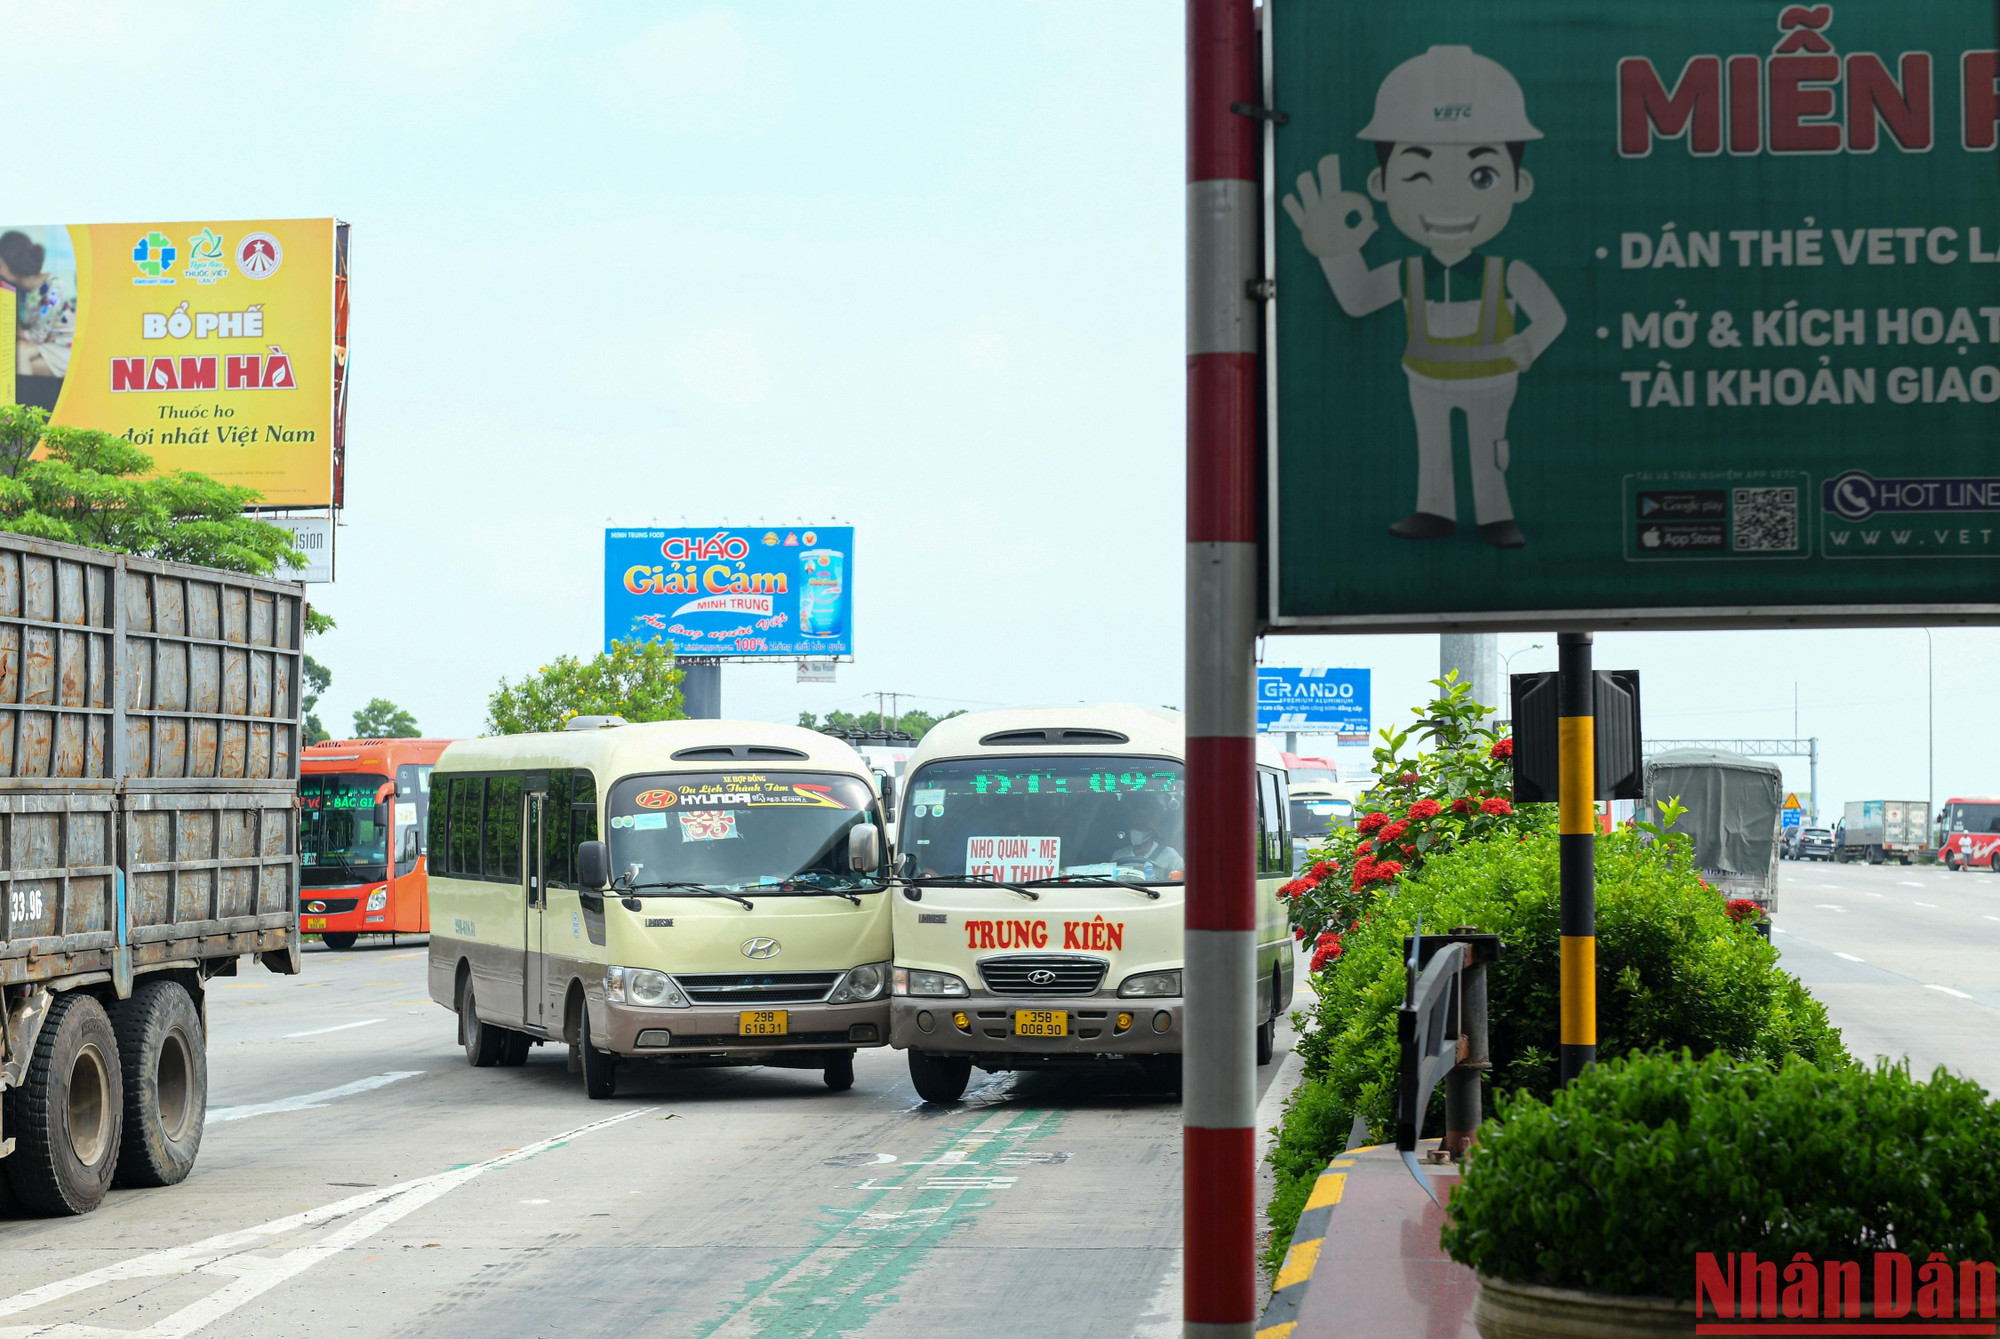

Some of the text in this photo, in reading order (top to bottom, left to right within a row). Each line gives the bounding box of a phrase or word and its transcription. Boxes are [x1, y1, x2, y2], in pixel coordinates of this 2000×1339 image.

[1617, 4, 1934, 158] MIỄN
[1621, 221, 1721, 269] DÁN
[1729, 216, 1824, 267] THẺ
[1831, 226, 1959, 266] VETC
[142, 301, 266, 340] BỔ PHẾ
[1622, 298, 2000, 355] MỞ & KÍCH HOẠT
[110, 345, 298, 393] NAM HÀ
[1620, 355, 2000, 408] TÀI KHOẢN GIAO
[158, 404, 235, 420] Thuốc ho
[161, 426, 209, 445] nhất
[216, 425, 259, 447] Việt
[264, 425, 316, 443] Nam
[1881, 483, 2000, 507] HOT LINE
[661, 531, 750, 561] CHÁO
[1664, 533, 1722, 547] App Store
[623, 562, 788, 595] Giải Cảm
[697, 598, 770, 612] MINH TRUNG
[735, 637, 768, 652] 100%
[1264, 682, 1354, 698] GRANDO
[680, 793, 752, 806] HYUNDAI
[970, 839, 994, 859] NHO
[998, 839, 1028, 860] QUAN
[1039, 839, 1057, 859] ME
[12, 890, 43, 922] 33.96
[965, 914, 1125, 951] TRUNG KIÊN
[753, 1011, 774, 1022] 29B
[1030, 1011, 1052, 1023] 35B
[745, 1023, 782, 1034] 618.31
[1021, 1023, 1062, 1035] 008.90
